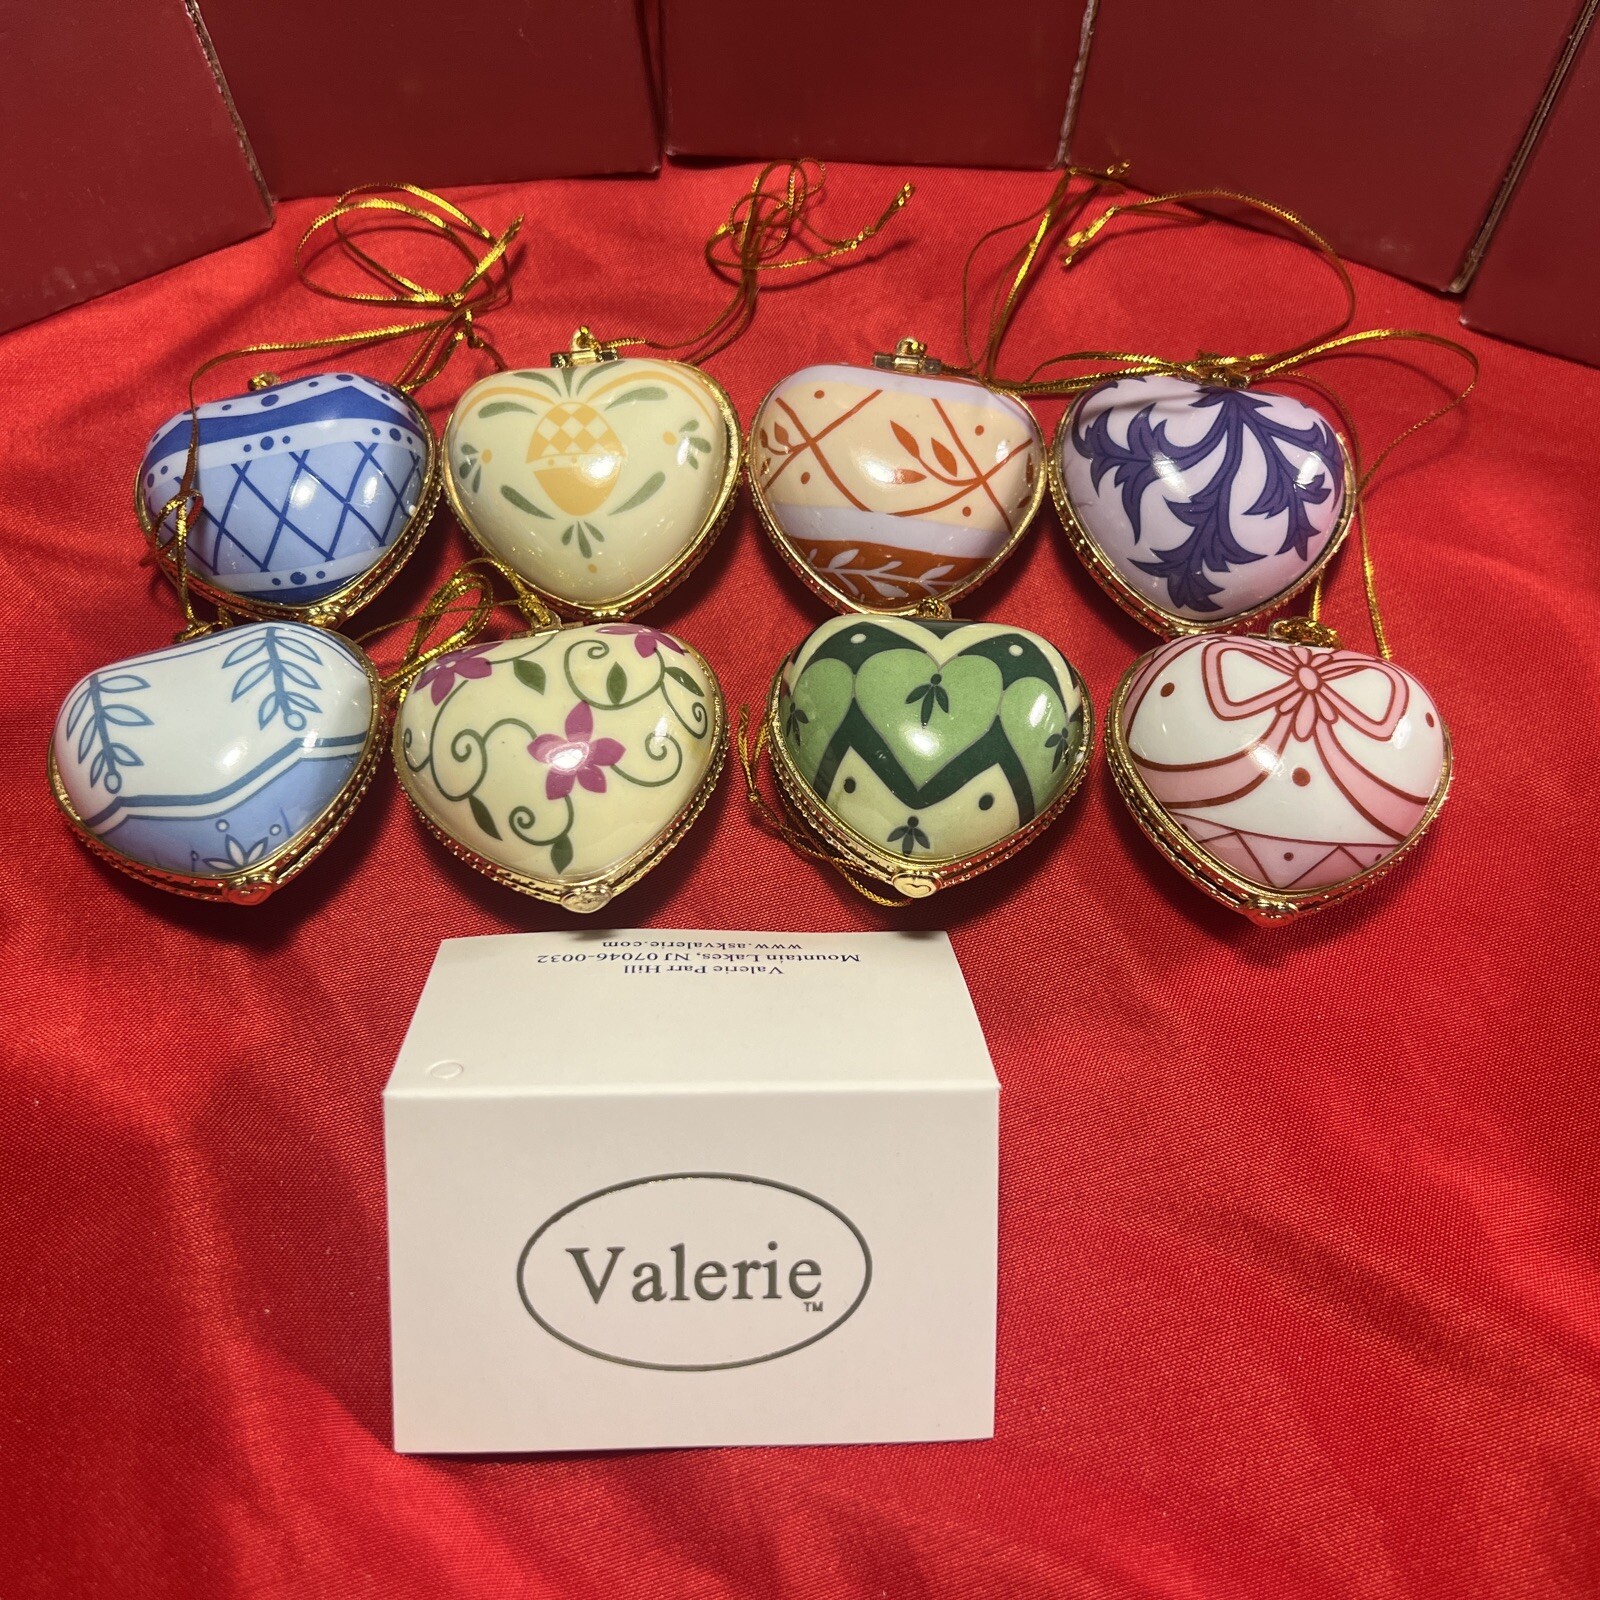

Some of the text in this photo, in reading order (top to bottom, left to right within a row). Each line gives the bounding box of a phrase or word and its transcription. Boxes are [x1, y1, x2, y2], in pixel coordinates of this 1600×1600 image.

[602, 940, 803, 950] www.askvalerie.com
[537, 952, 861, 963] Mountain Lakes, NJ 07046-0032
[623, 964, 784, 975] Valerie Parr Hill
[565, 1240, 822, 1305] Valerie
